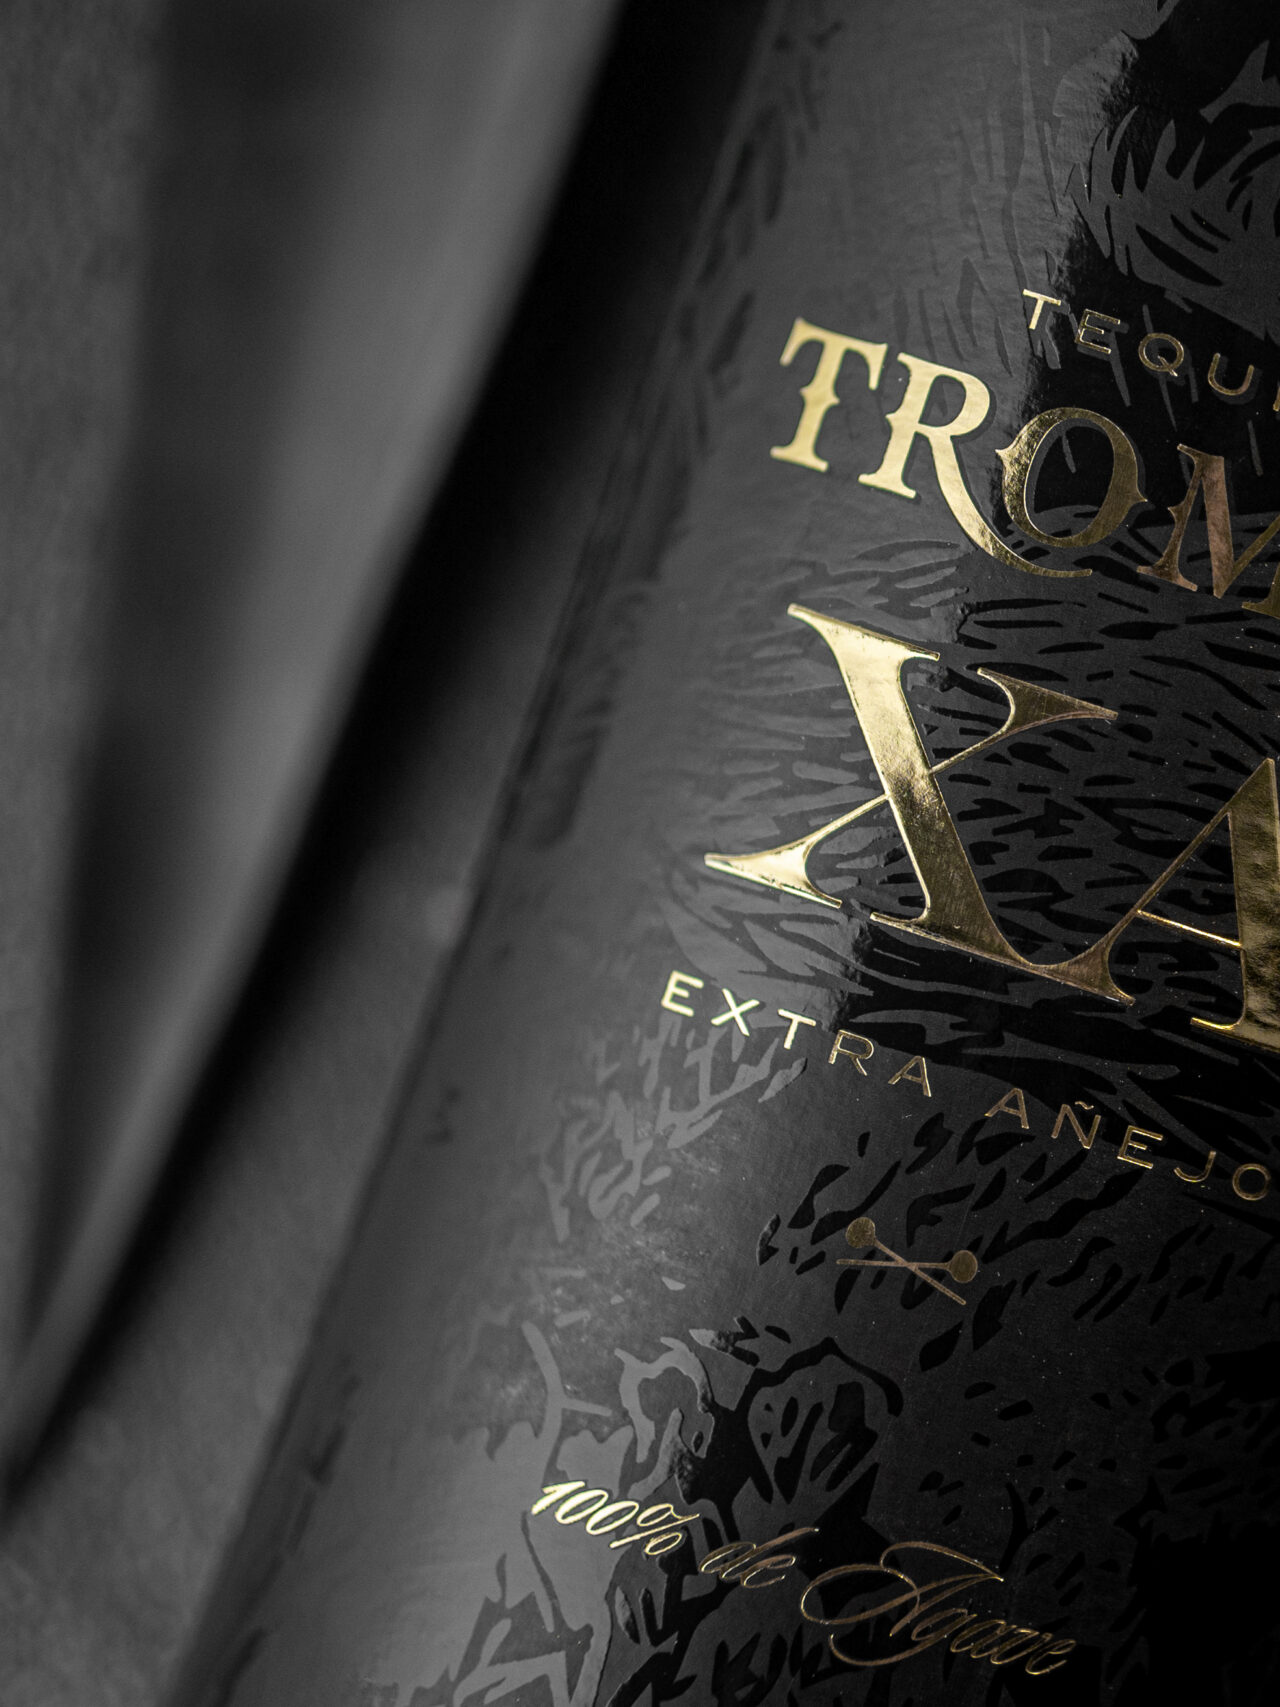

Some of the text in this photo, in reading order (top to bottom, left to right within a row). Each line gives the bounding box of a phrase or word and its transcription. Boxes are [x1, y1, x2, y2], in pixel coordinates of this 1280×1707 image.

[660, 969, 1273, 1201] EXTRA AÑEJO
[531, 1480, 1076, 1676] 100% de Agave
